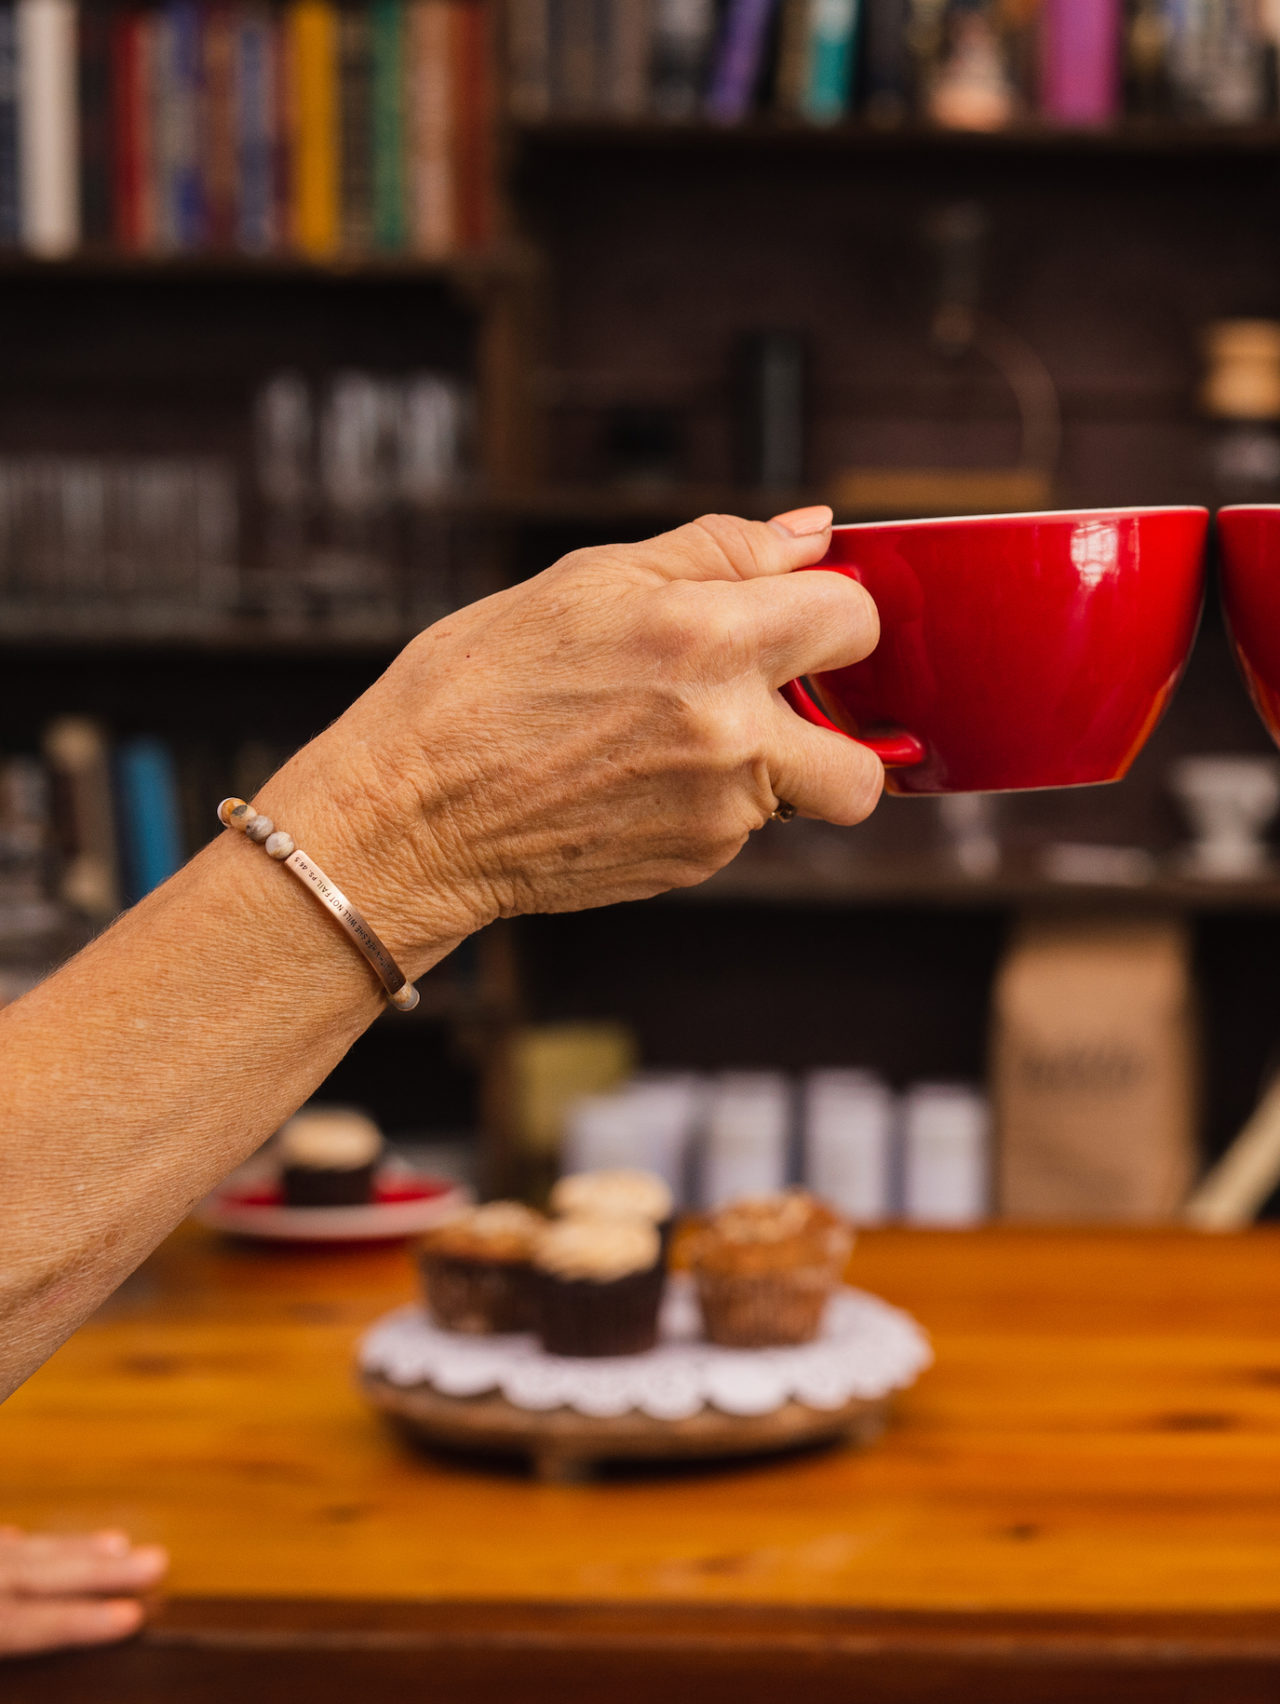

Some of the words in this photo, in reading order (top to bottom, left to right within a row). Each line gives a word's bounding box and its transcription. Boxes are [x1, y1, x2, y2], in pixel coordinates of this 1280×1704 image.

[317, 879, 331, 897] FAIL
[330, 896, 342, 911] NOT
[343, 910, 357, 927] WILL
[354, 926, 368, 939] SHE
